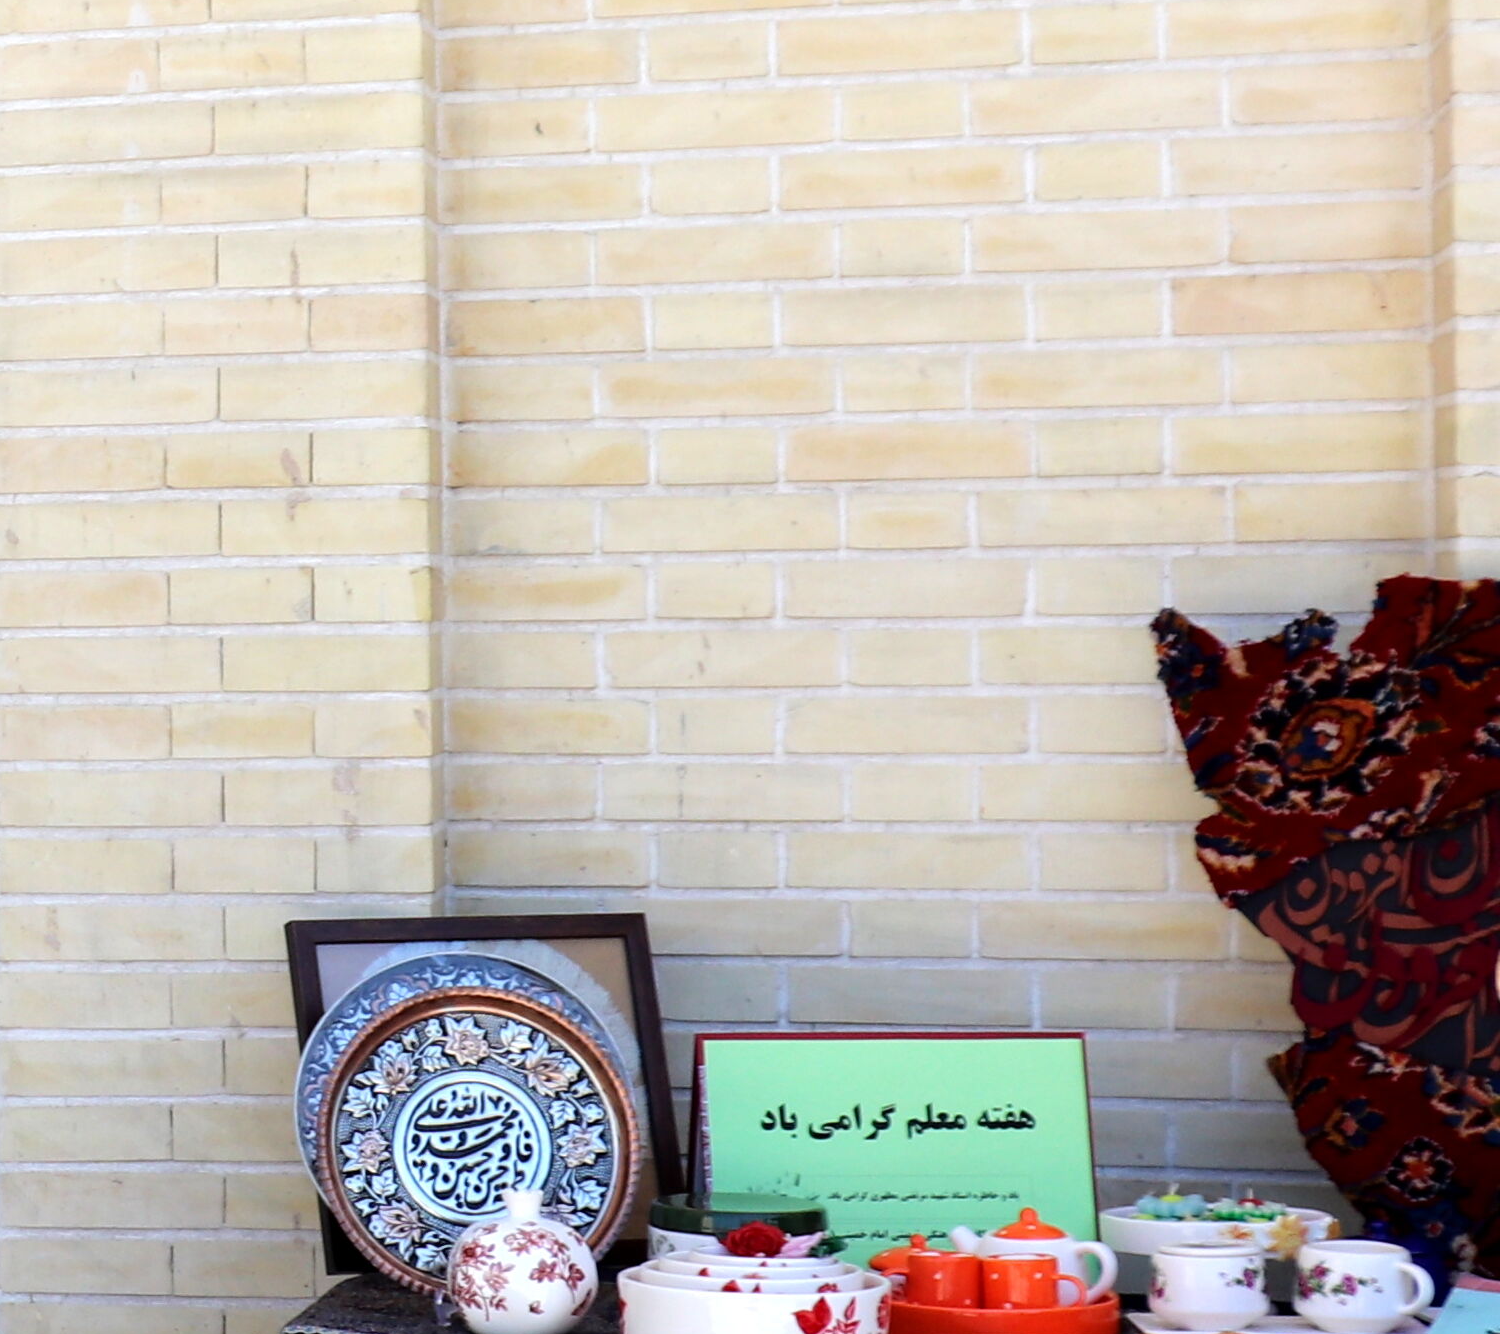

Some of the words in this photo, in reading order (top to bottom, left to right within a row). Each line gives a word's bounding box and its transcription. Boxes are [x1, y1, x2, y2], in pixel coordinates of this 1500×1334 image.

[760, 1104, 798, 1138] باد
[808, 1103, 896, 1140] گرامی
[907, 1103, 967, 1139] معلم
[977, 1104, 1036, 1130] هفته
